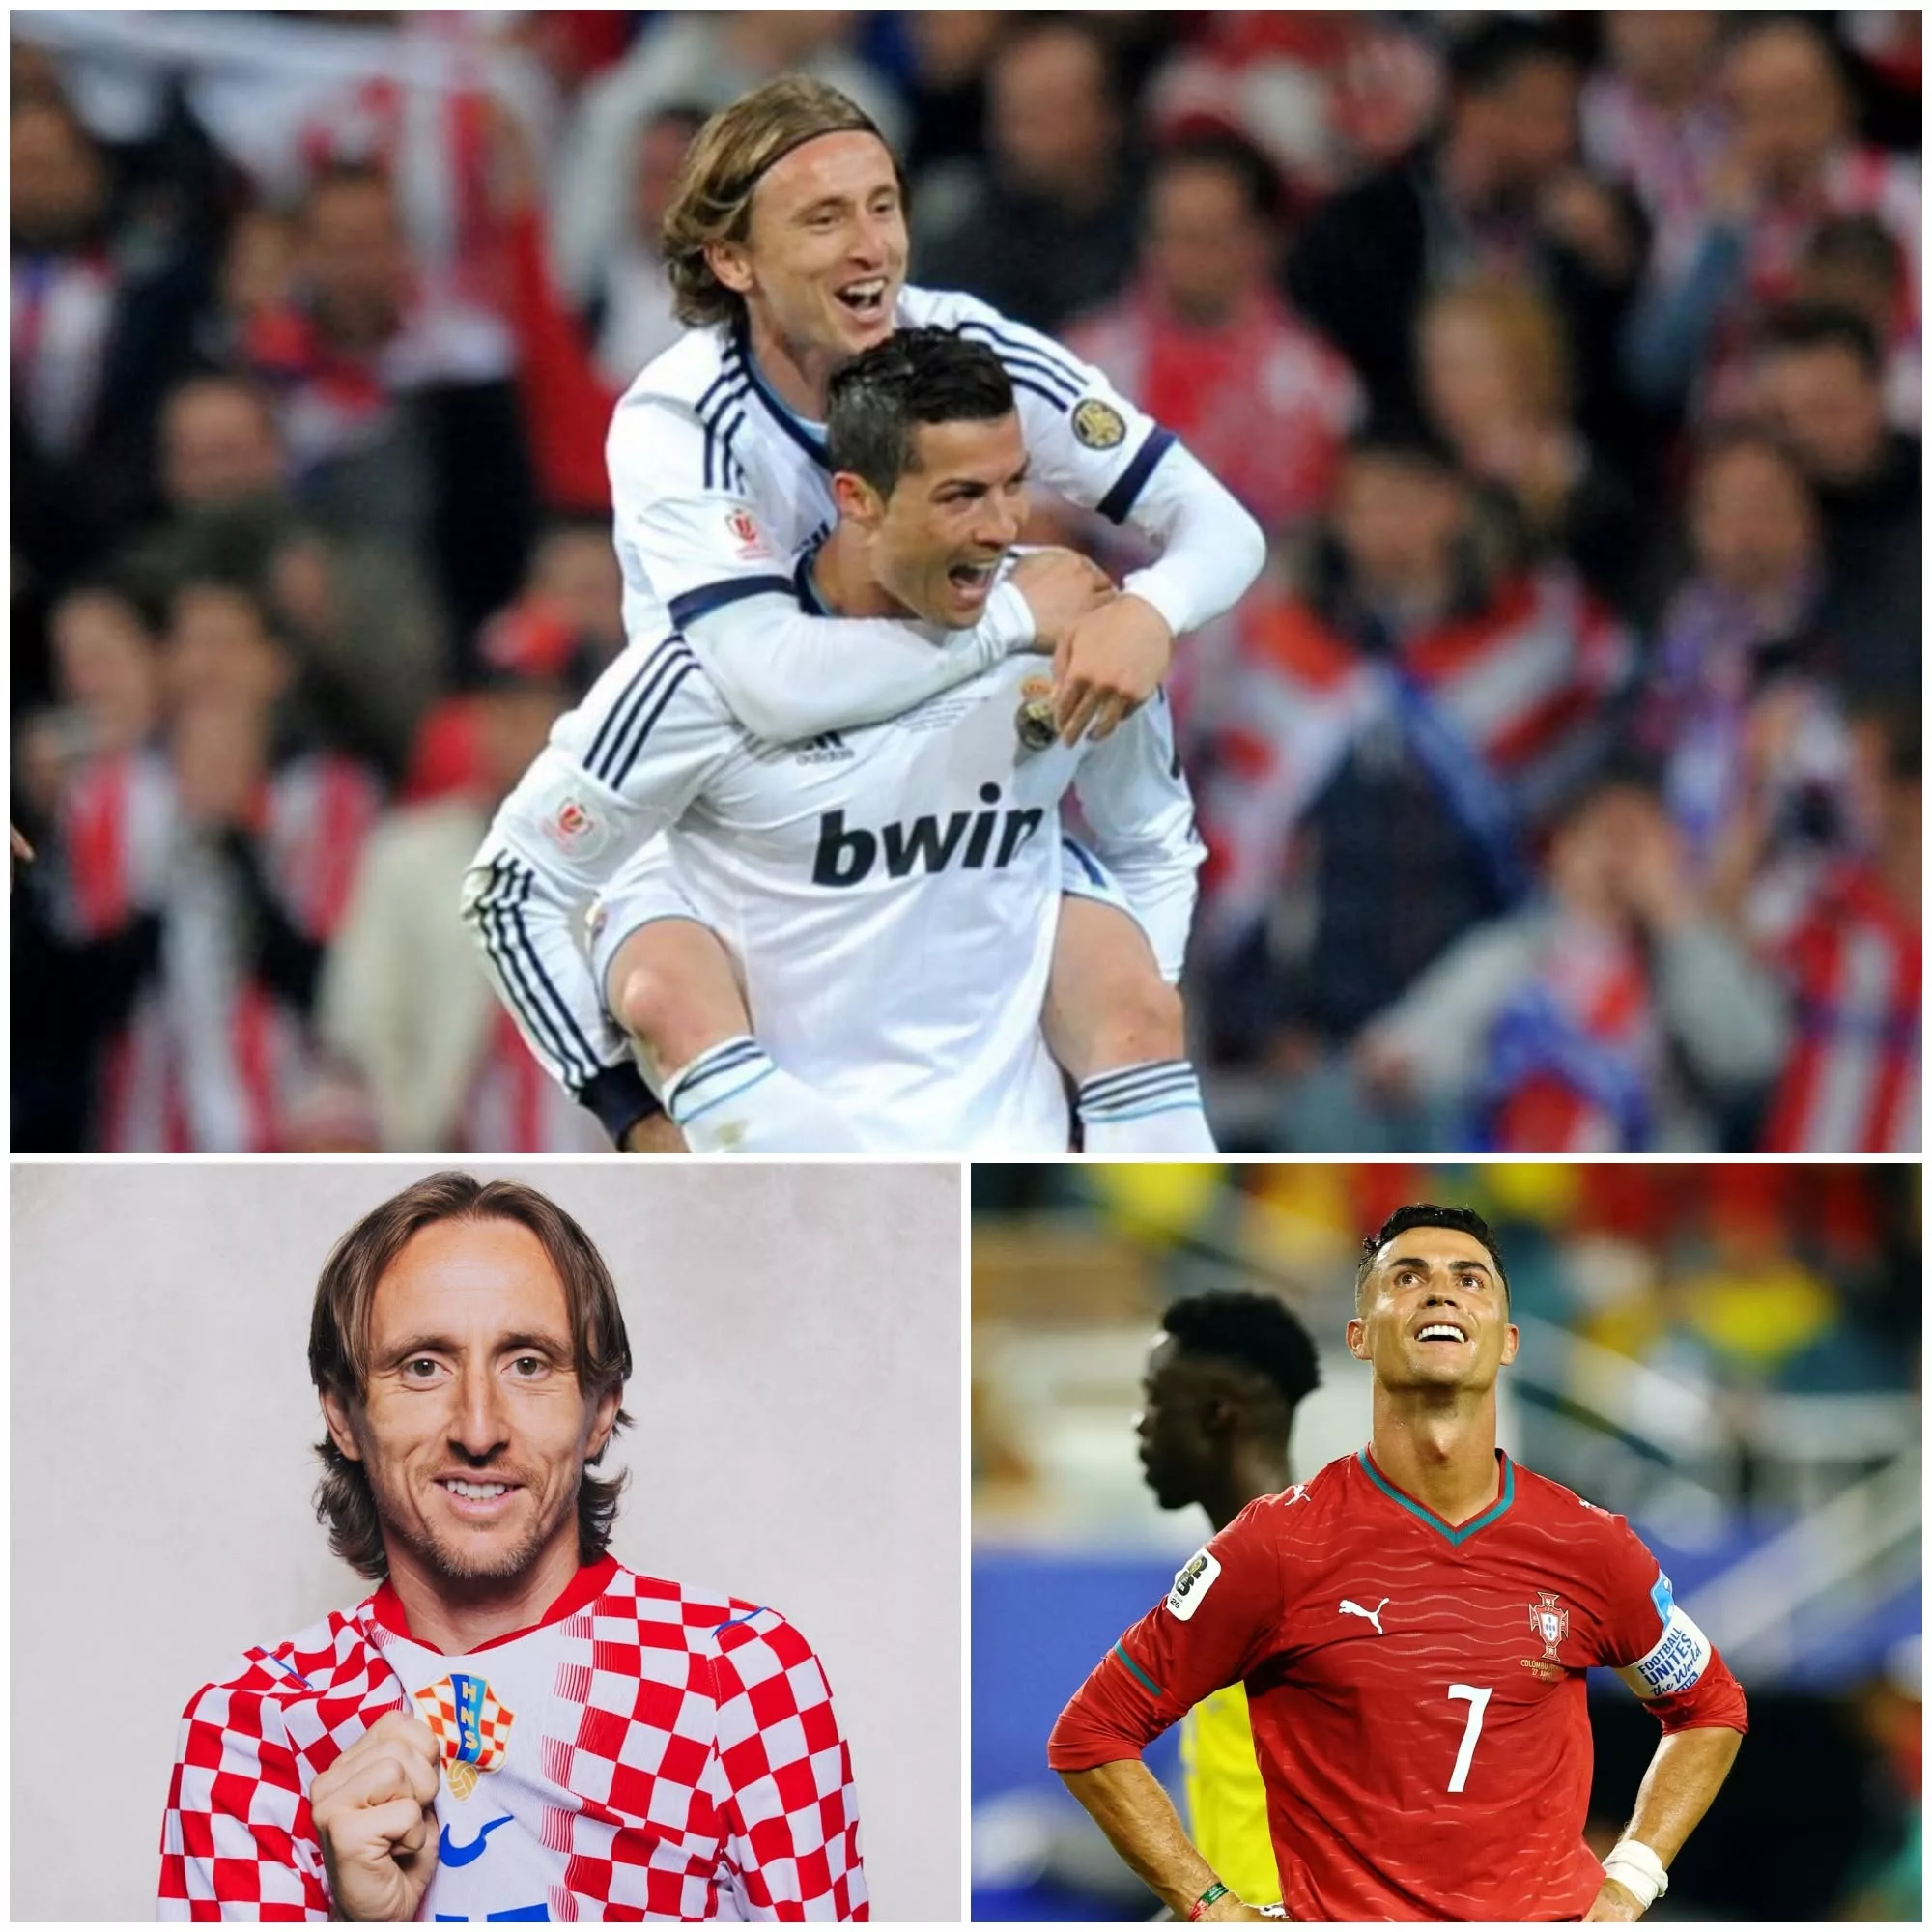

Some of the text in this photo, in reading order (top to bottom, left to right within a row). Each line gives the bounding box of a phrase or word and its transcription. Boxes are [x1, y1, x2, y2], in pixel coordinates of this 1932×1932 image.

[1637, 1627, 1682, 1674] FOOTBALL
[1644, 1633, 1692, 1686] UNITES
[1650, 1641, 1702, 1697] the World
[460, 1681, 479, 1750] HNS
[1446, 1683, 1493, 1793] 7
